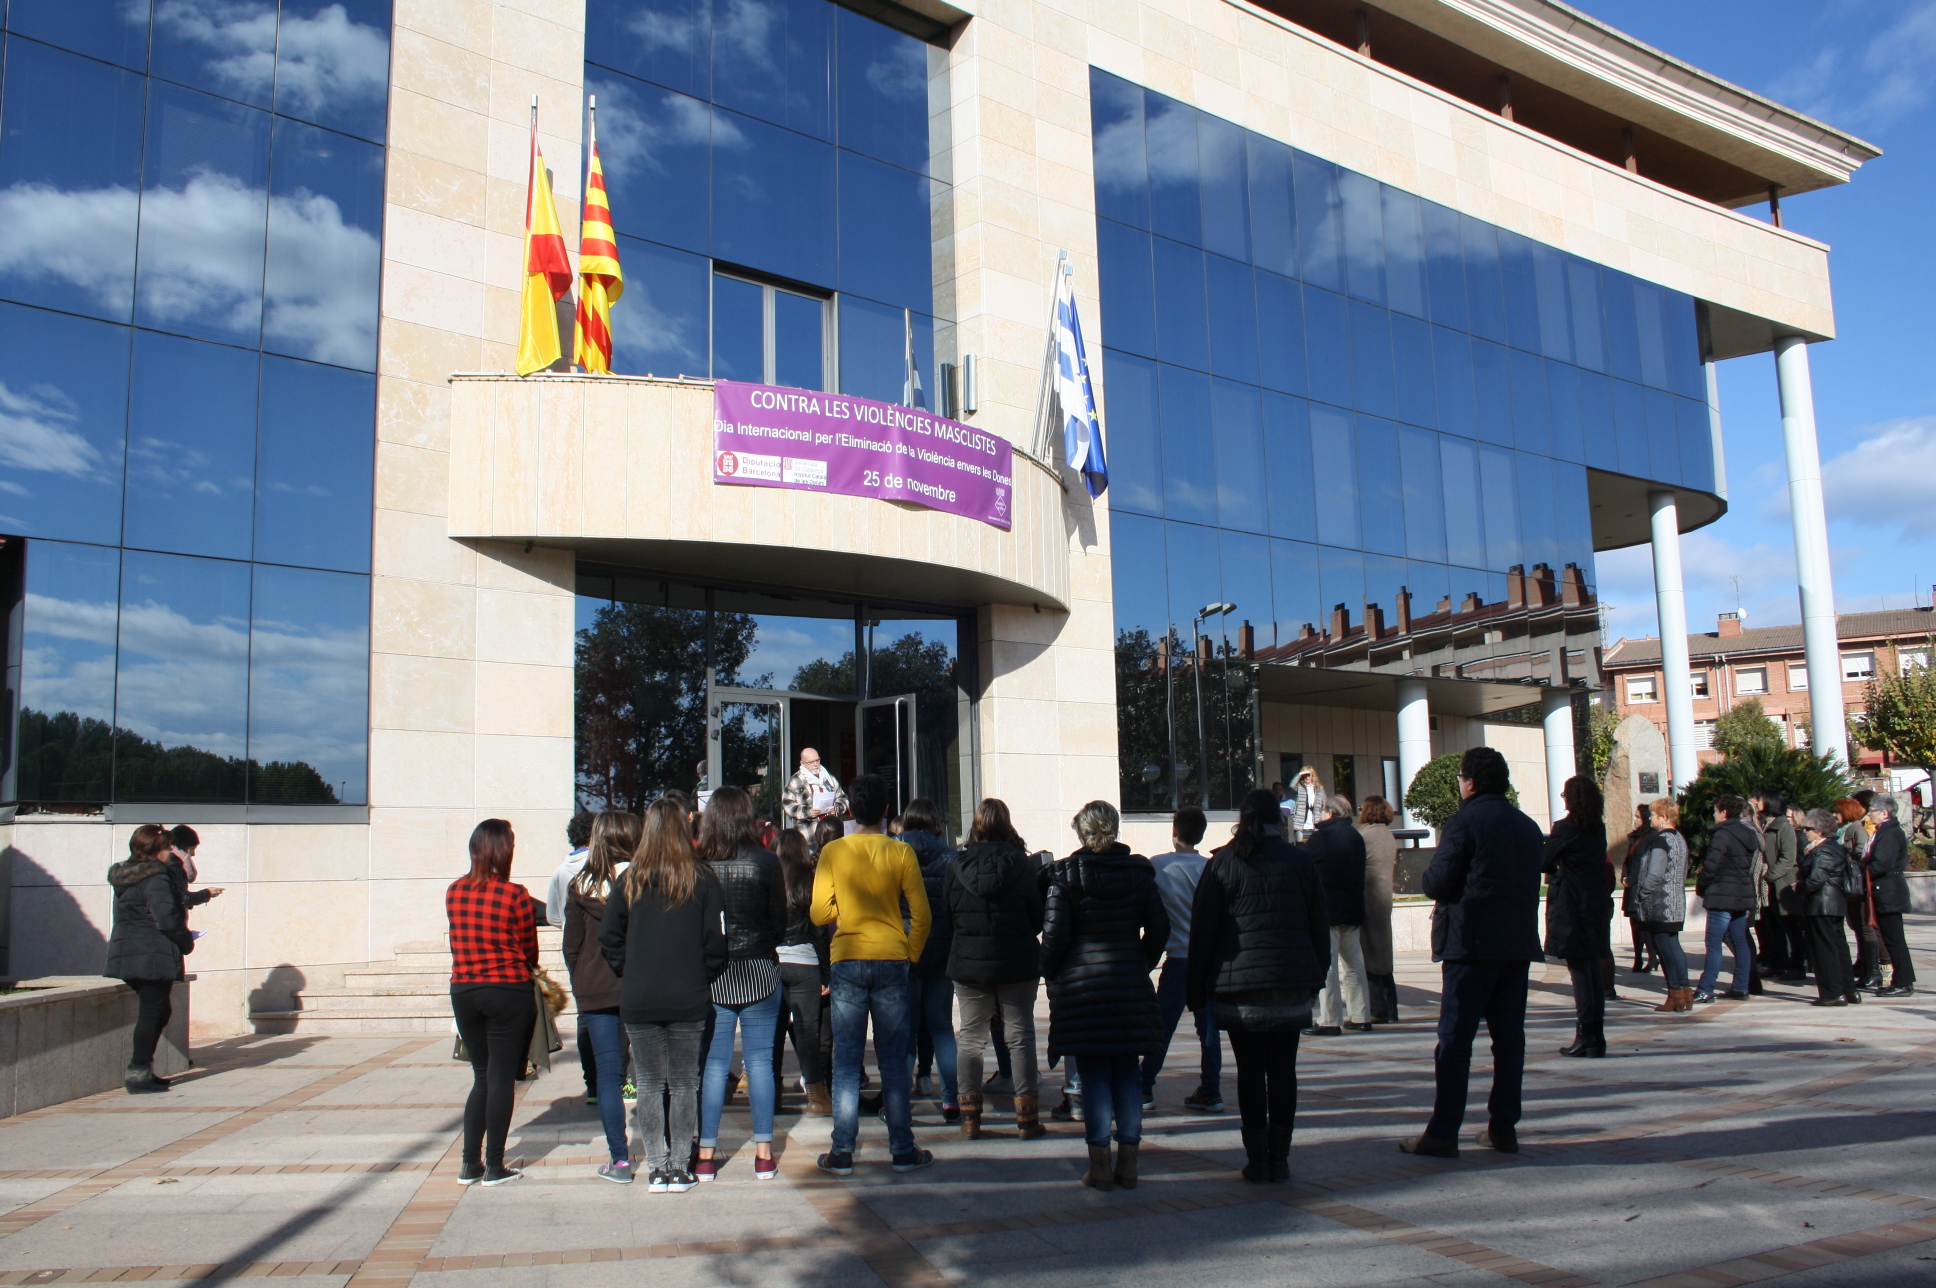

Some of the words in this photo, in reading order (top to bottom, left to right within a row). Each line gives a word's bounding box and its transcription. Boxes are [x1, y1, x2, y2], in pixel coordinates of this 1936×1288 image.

[751, 391, 821, 415] CONTRA
[825, 400, 850, 419] LES
[853, 403, 931, 435] VIOLÈNCIES
[934, 422, 996, 456] MASCLISTES
[714, 420, 734, 434] Dia
[737, 422, 812, 442] Internacional
[815, 433, 833, 445] per
[895, 441, 907, 454] de
[908, 445, 915, 458] la
[917, 448, 955, 468] Violència
[957, 460, 981, 476] envers
[982, 466, 991, 480] les
[992, 470, 1012, 487] Dones
[742, 457, 781, 468] Diputació
[742, 467, 781, 478] Barcelona
[863, 470, 880, 487] 25
[884, 472, 903, 488] de
[907, 477, 956, 503] novembre
